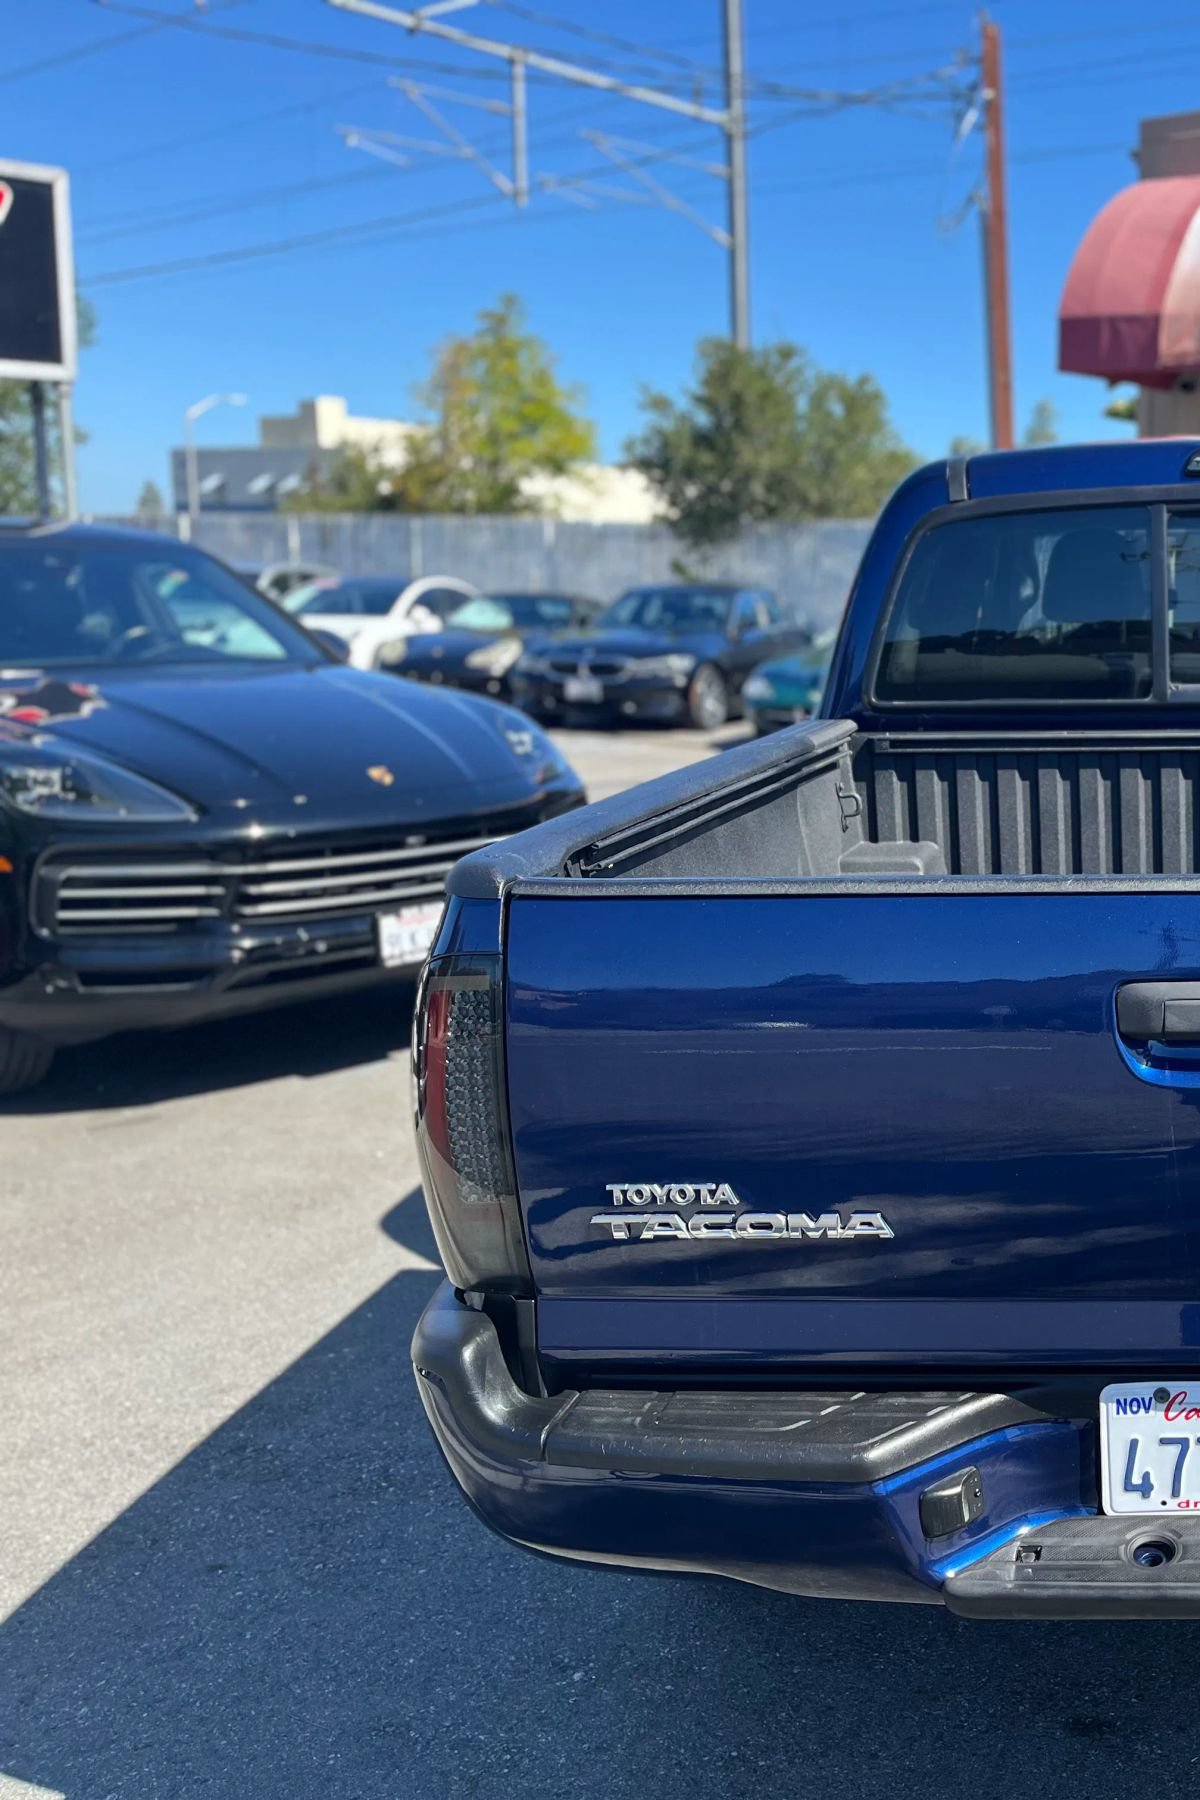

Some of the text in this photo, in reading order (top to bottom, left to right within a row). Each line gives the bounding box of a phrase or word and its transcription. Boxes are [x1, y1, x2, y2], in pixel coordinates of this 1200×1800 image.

[605, 1182, 740, 1206] TOYOTA
[590, 1210, 895, 1240] TACOMA
[1115, 1396, 1153, 1416] NOV
